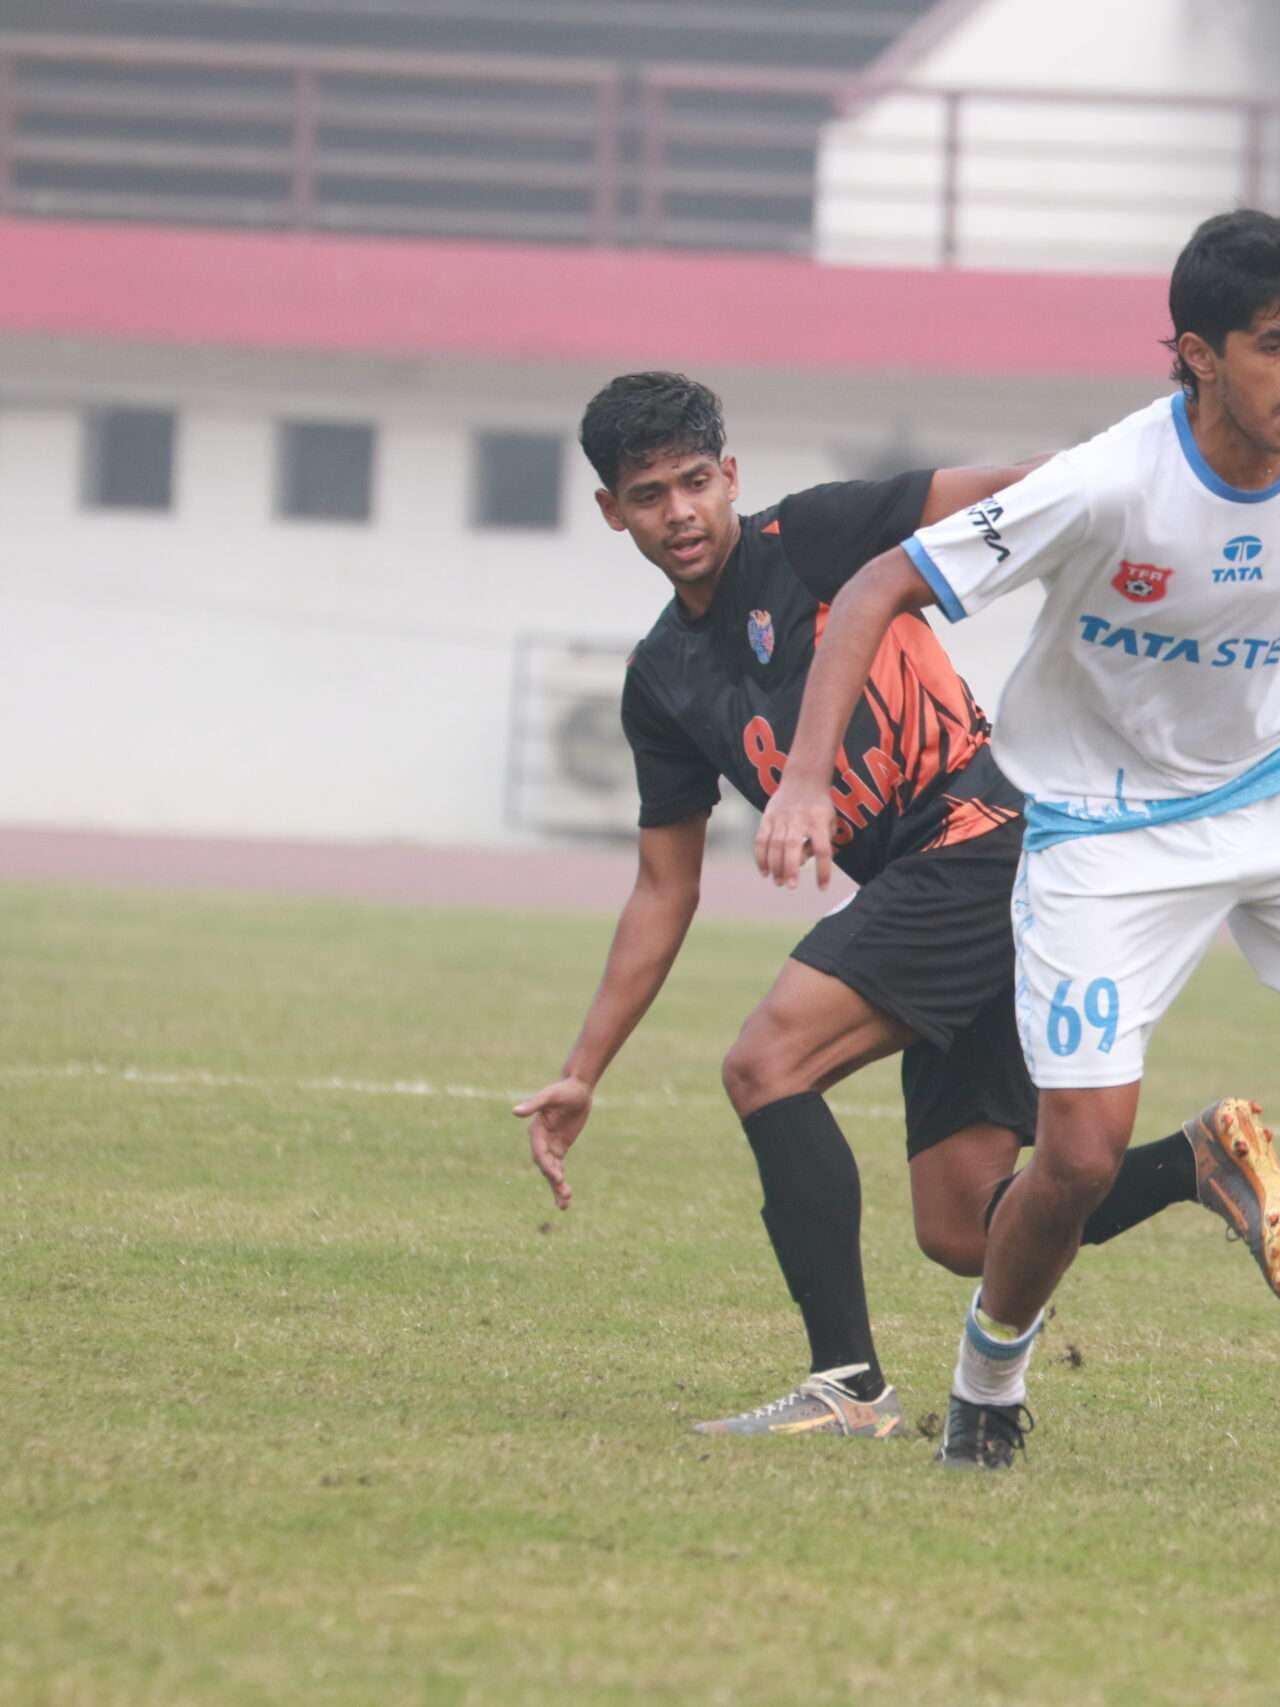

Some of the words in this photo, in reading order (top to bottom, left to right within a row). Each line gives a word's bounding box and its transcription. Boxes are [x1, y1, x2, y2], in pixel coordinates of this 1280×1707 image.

[1211, 566, 1264, 583] TATA
[1079, 614, 1200, 664] TATA
[743, 715, 791, 800] 8
[1047, 976, 1119, 1057] 69
